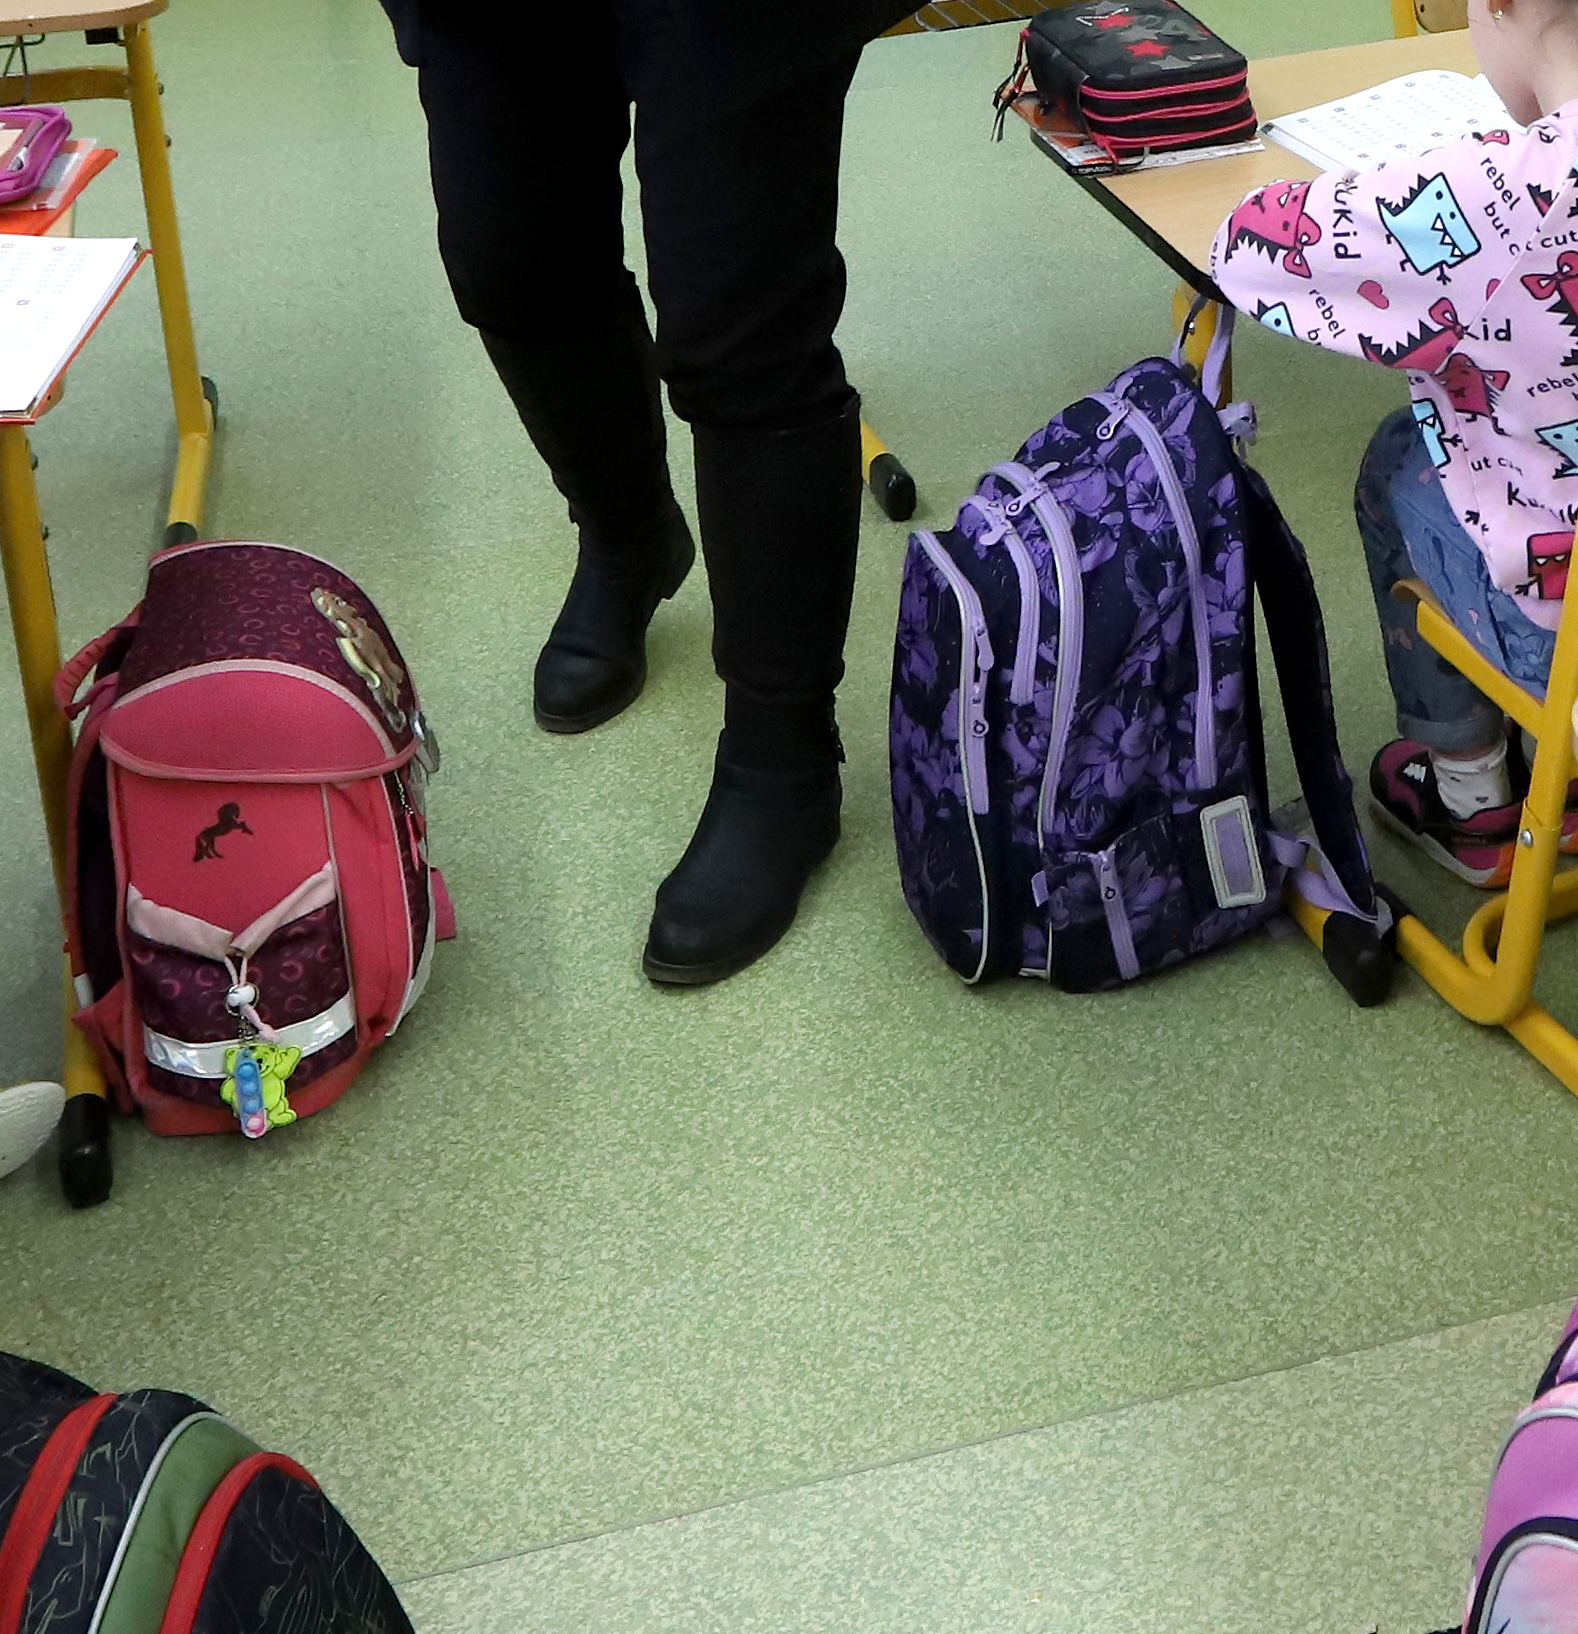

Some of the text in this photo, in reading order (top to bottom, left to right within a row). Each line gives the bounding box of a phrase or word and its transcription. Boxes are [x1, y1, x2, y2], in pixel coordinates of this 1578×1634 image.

[1481, 157, 1521, 211] rebel
[1484, 203, 1510, 239] but
[1309, 288, 1346, 339] rebel
